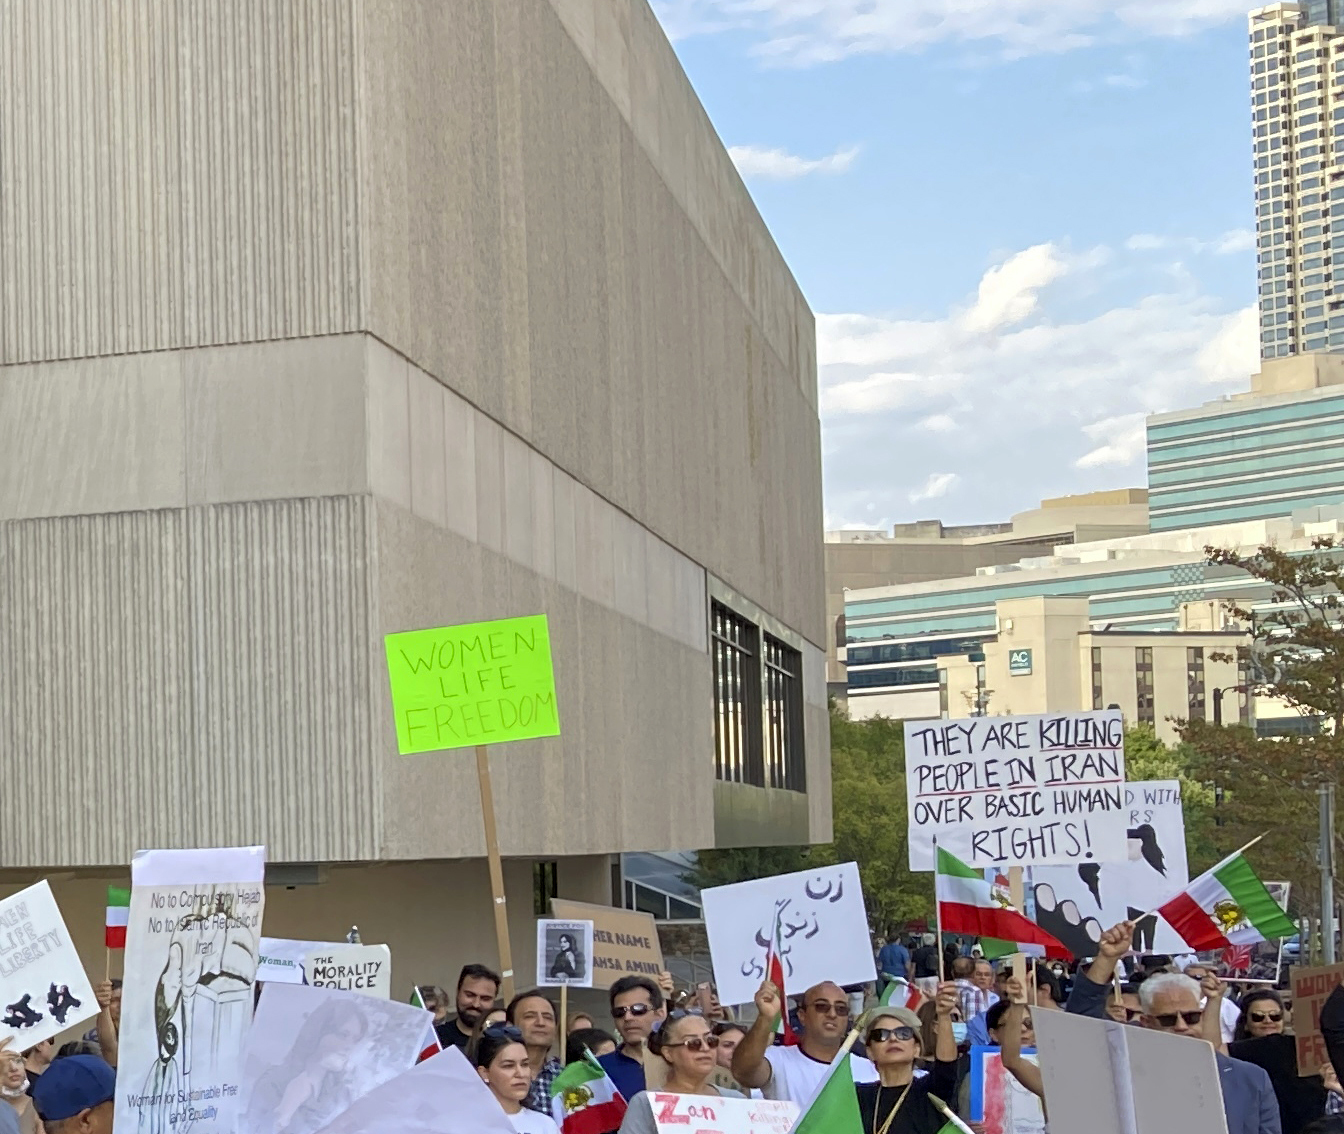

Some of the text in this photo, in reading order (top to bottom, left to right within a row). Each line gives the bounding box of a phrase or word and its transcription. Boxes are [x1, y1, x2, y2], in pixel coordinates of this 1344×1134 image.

[400, 627, 536, 675] WOMEN
[1010, 651, 1029, 663] AC
[438, 664, 517, 699] LIFE
[405, 691, 556, 747] FREEDOM
[912, 717, 1123, 756] THEY ARE KILLING
[913, 751, 1120, 794] PEOPLE IN IRAN
[914, 784, 1122, 825] OVER BASIC HUMAN
[1143, 788, 1182, 806] WITH
[971, 819, 1094, 861] RIGHTS!
[150, 891, 165, 909] No
[167, 893, 177, 909] to
[804, 873, 844, 903] زن
[148, 916, 163, 933] No
[164, 917, 175, 933] to
[194, 938, 214, 955] Iran
[593, 929, 652, 950] HER NAME
[313, 956, 333, 965] THE
[313, 961, 382, 980] MORALITY
[592, 956, 662, 976] AHSA AMINI
[654, 1094, 717, 1125] Zan
